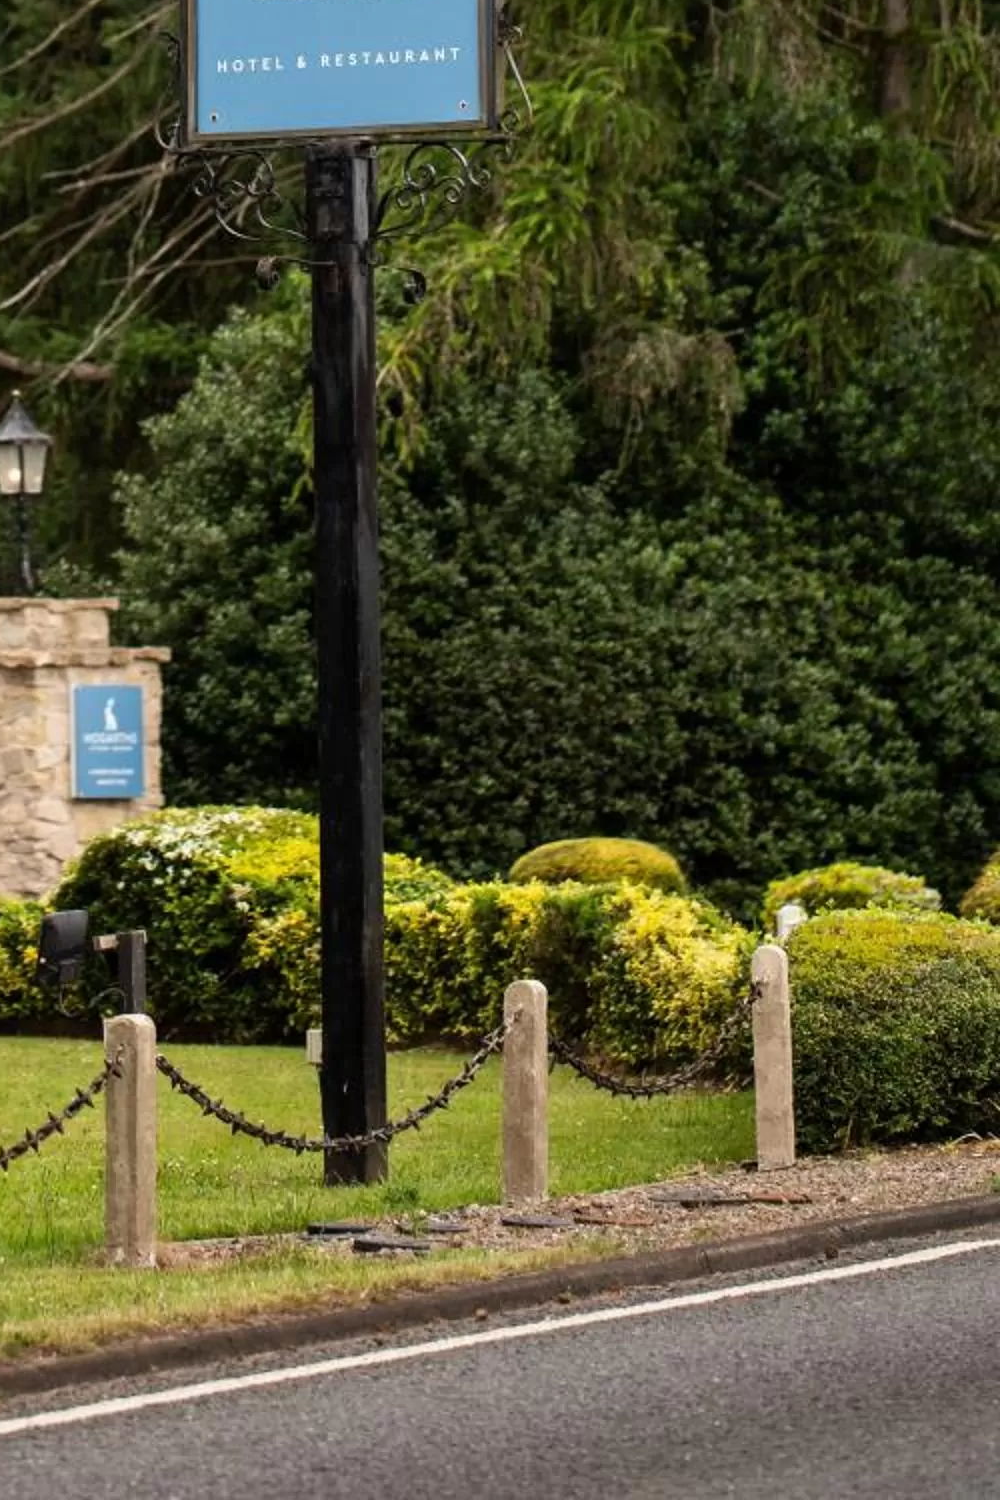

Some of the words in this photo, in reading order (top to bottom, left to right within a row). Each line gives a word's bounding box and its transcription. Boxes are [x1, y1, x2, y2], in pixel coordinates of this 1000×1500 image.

[217, 57, 284, 73] HOTEL
[296, 55, 307, 69] &
[321, 47, 461, 68] RESTAURANT
